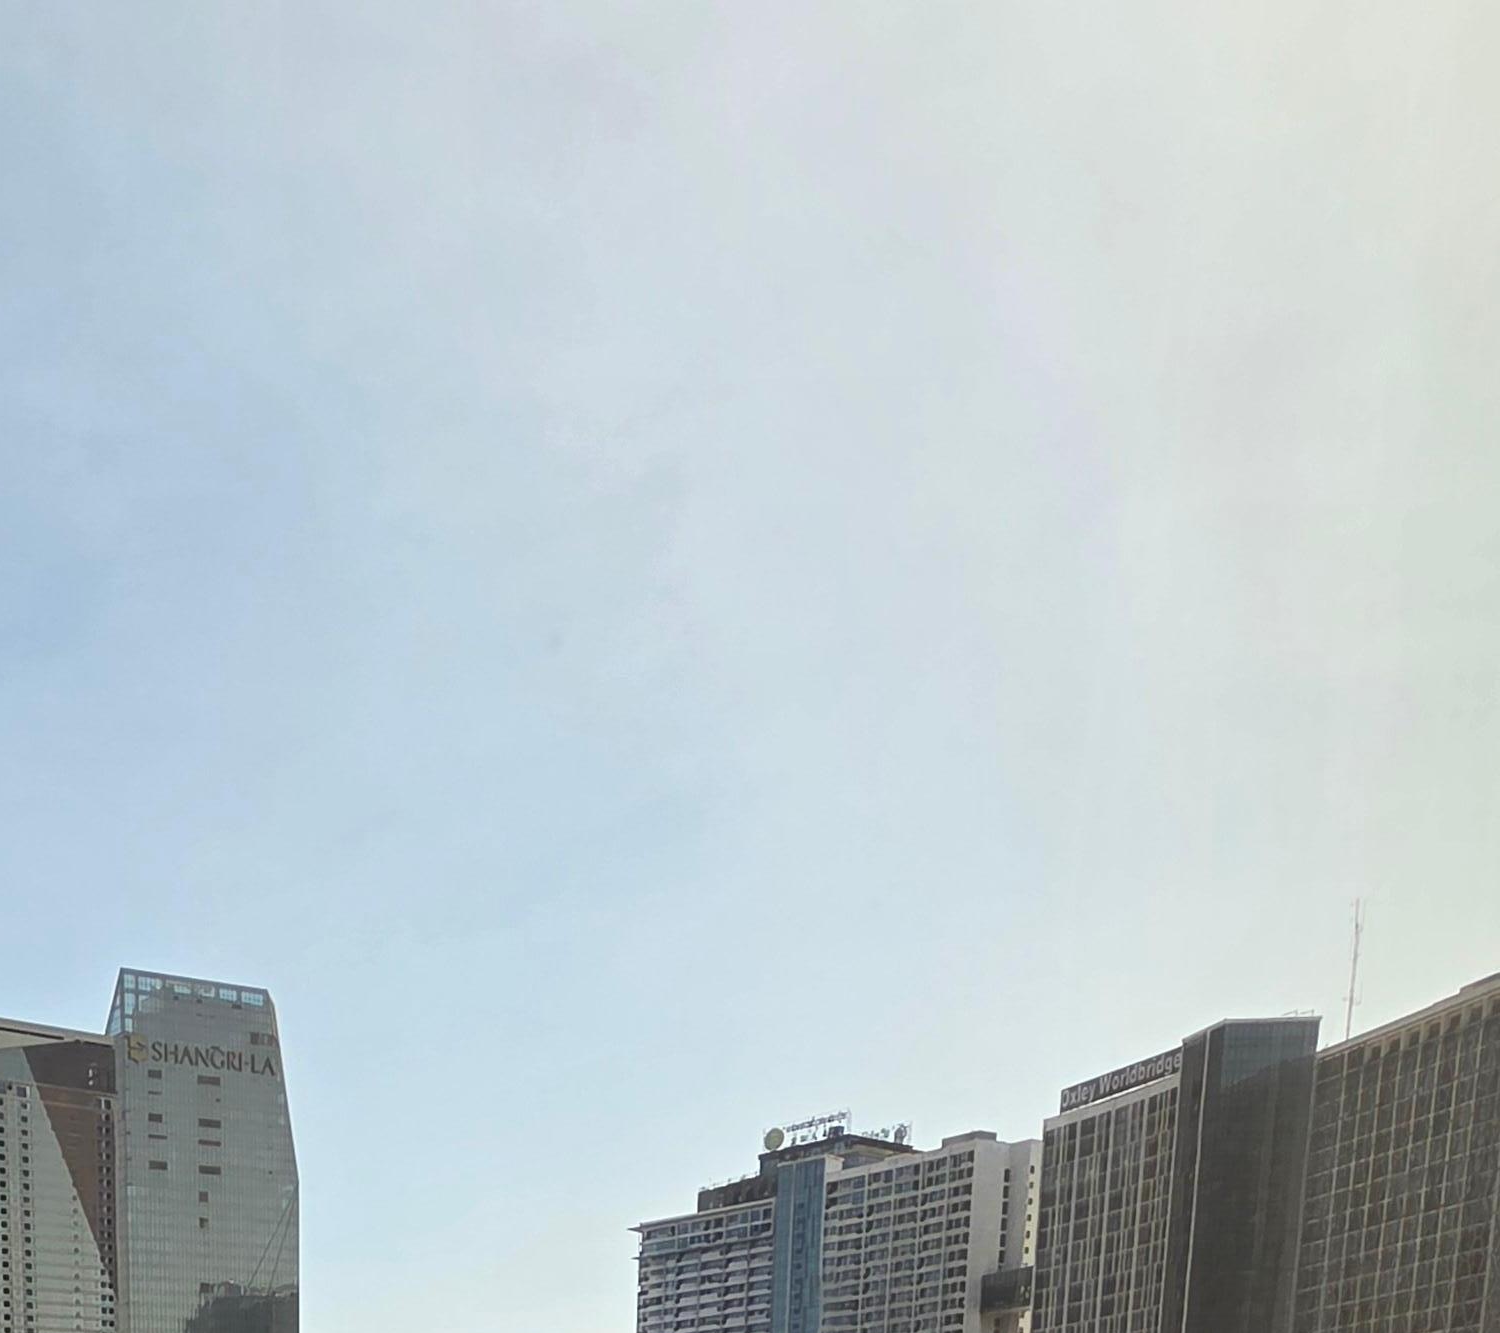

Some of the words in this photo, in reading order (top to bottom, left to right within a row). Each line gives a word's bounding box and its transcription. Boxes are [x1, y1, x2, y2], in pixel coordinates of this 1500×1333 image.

[151, 1040, 275, 1076] SHANGRI-LA
[1062, 1083, 1096, 1108] Oxley
[1100, 1052, 1181, 1094] Worldbridge
